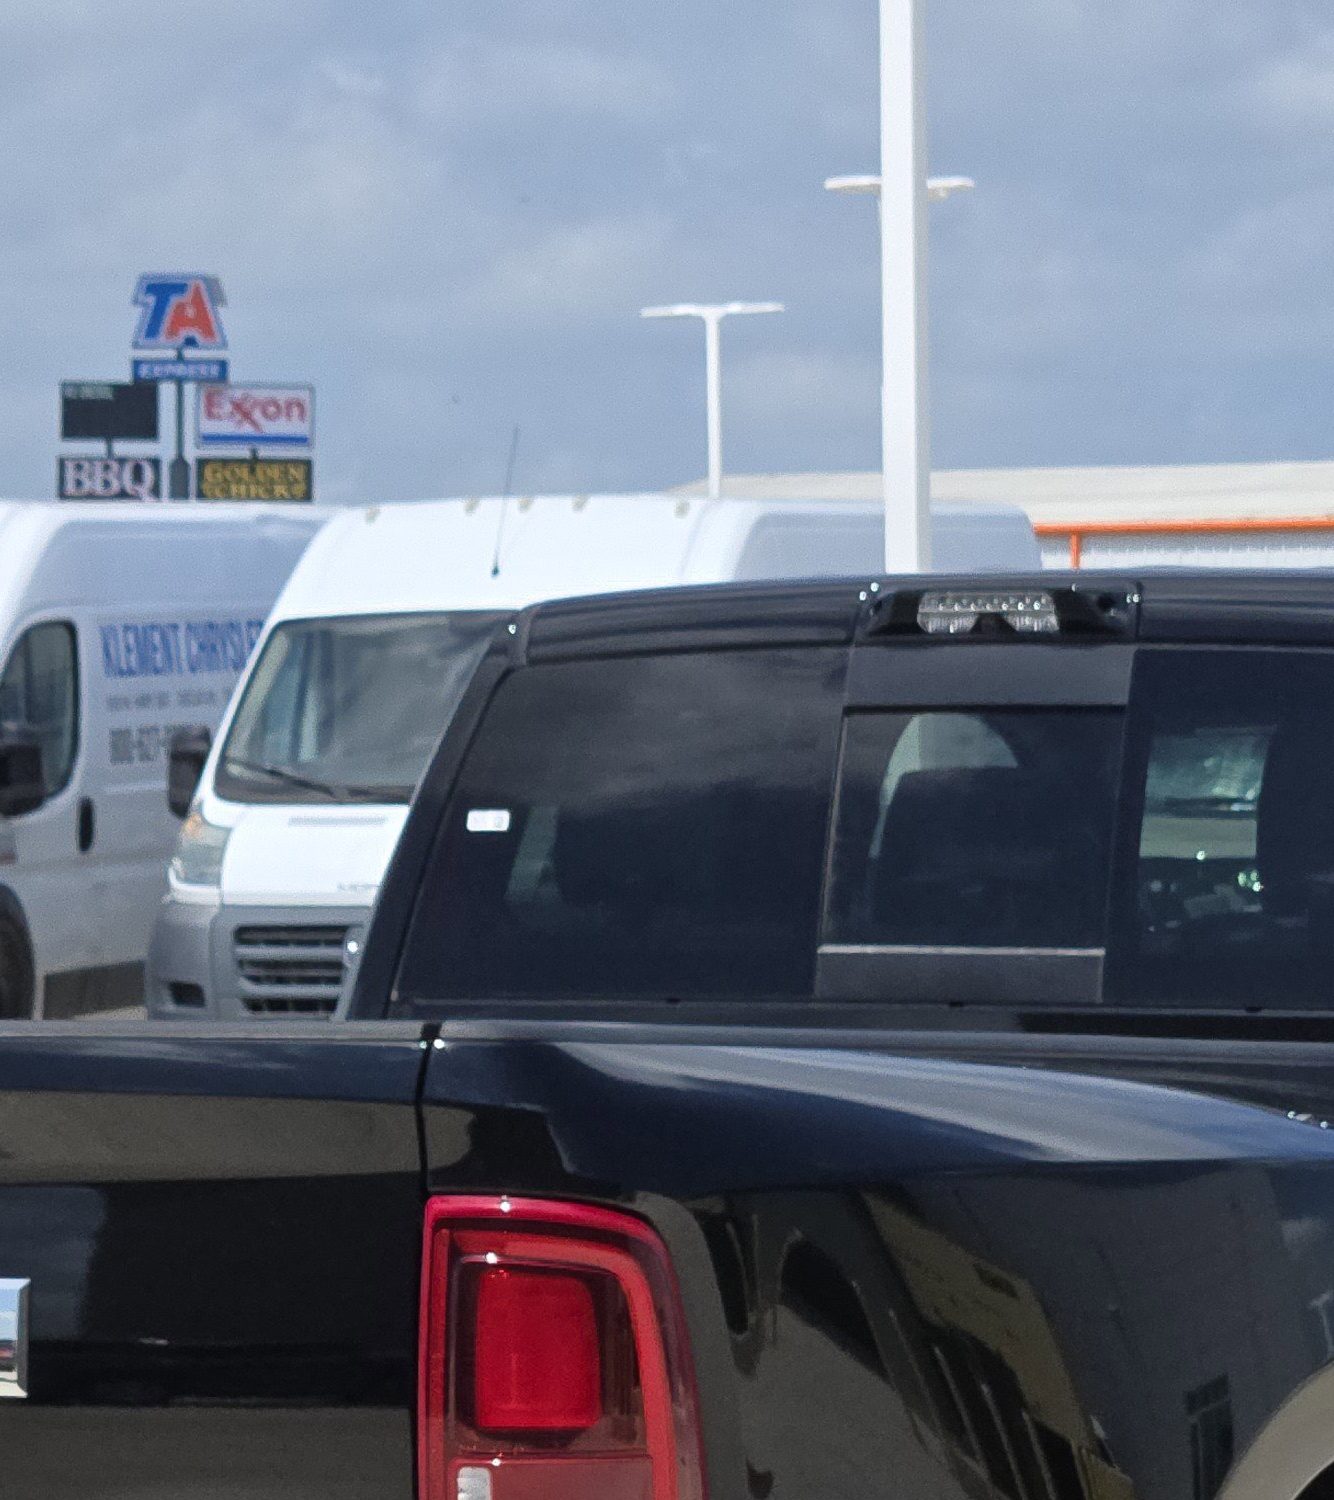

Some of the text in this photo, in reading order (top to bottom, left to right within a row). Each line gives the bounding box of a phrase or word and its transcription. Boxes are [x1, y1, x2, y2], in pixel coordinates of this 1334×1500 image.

[144, 281, 218, 342] TA
[203, 386, 308, 432] Exxon
[63, 459, 157, 501] BBQ
